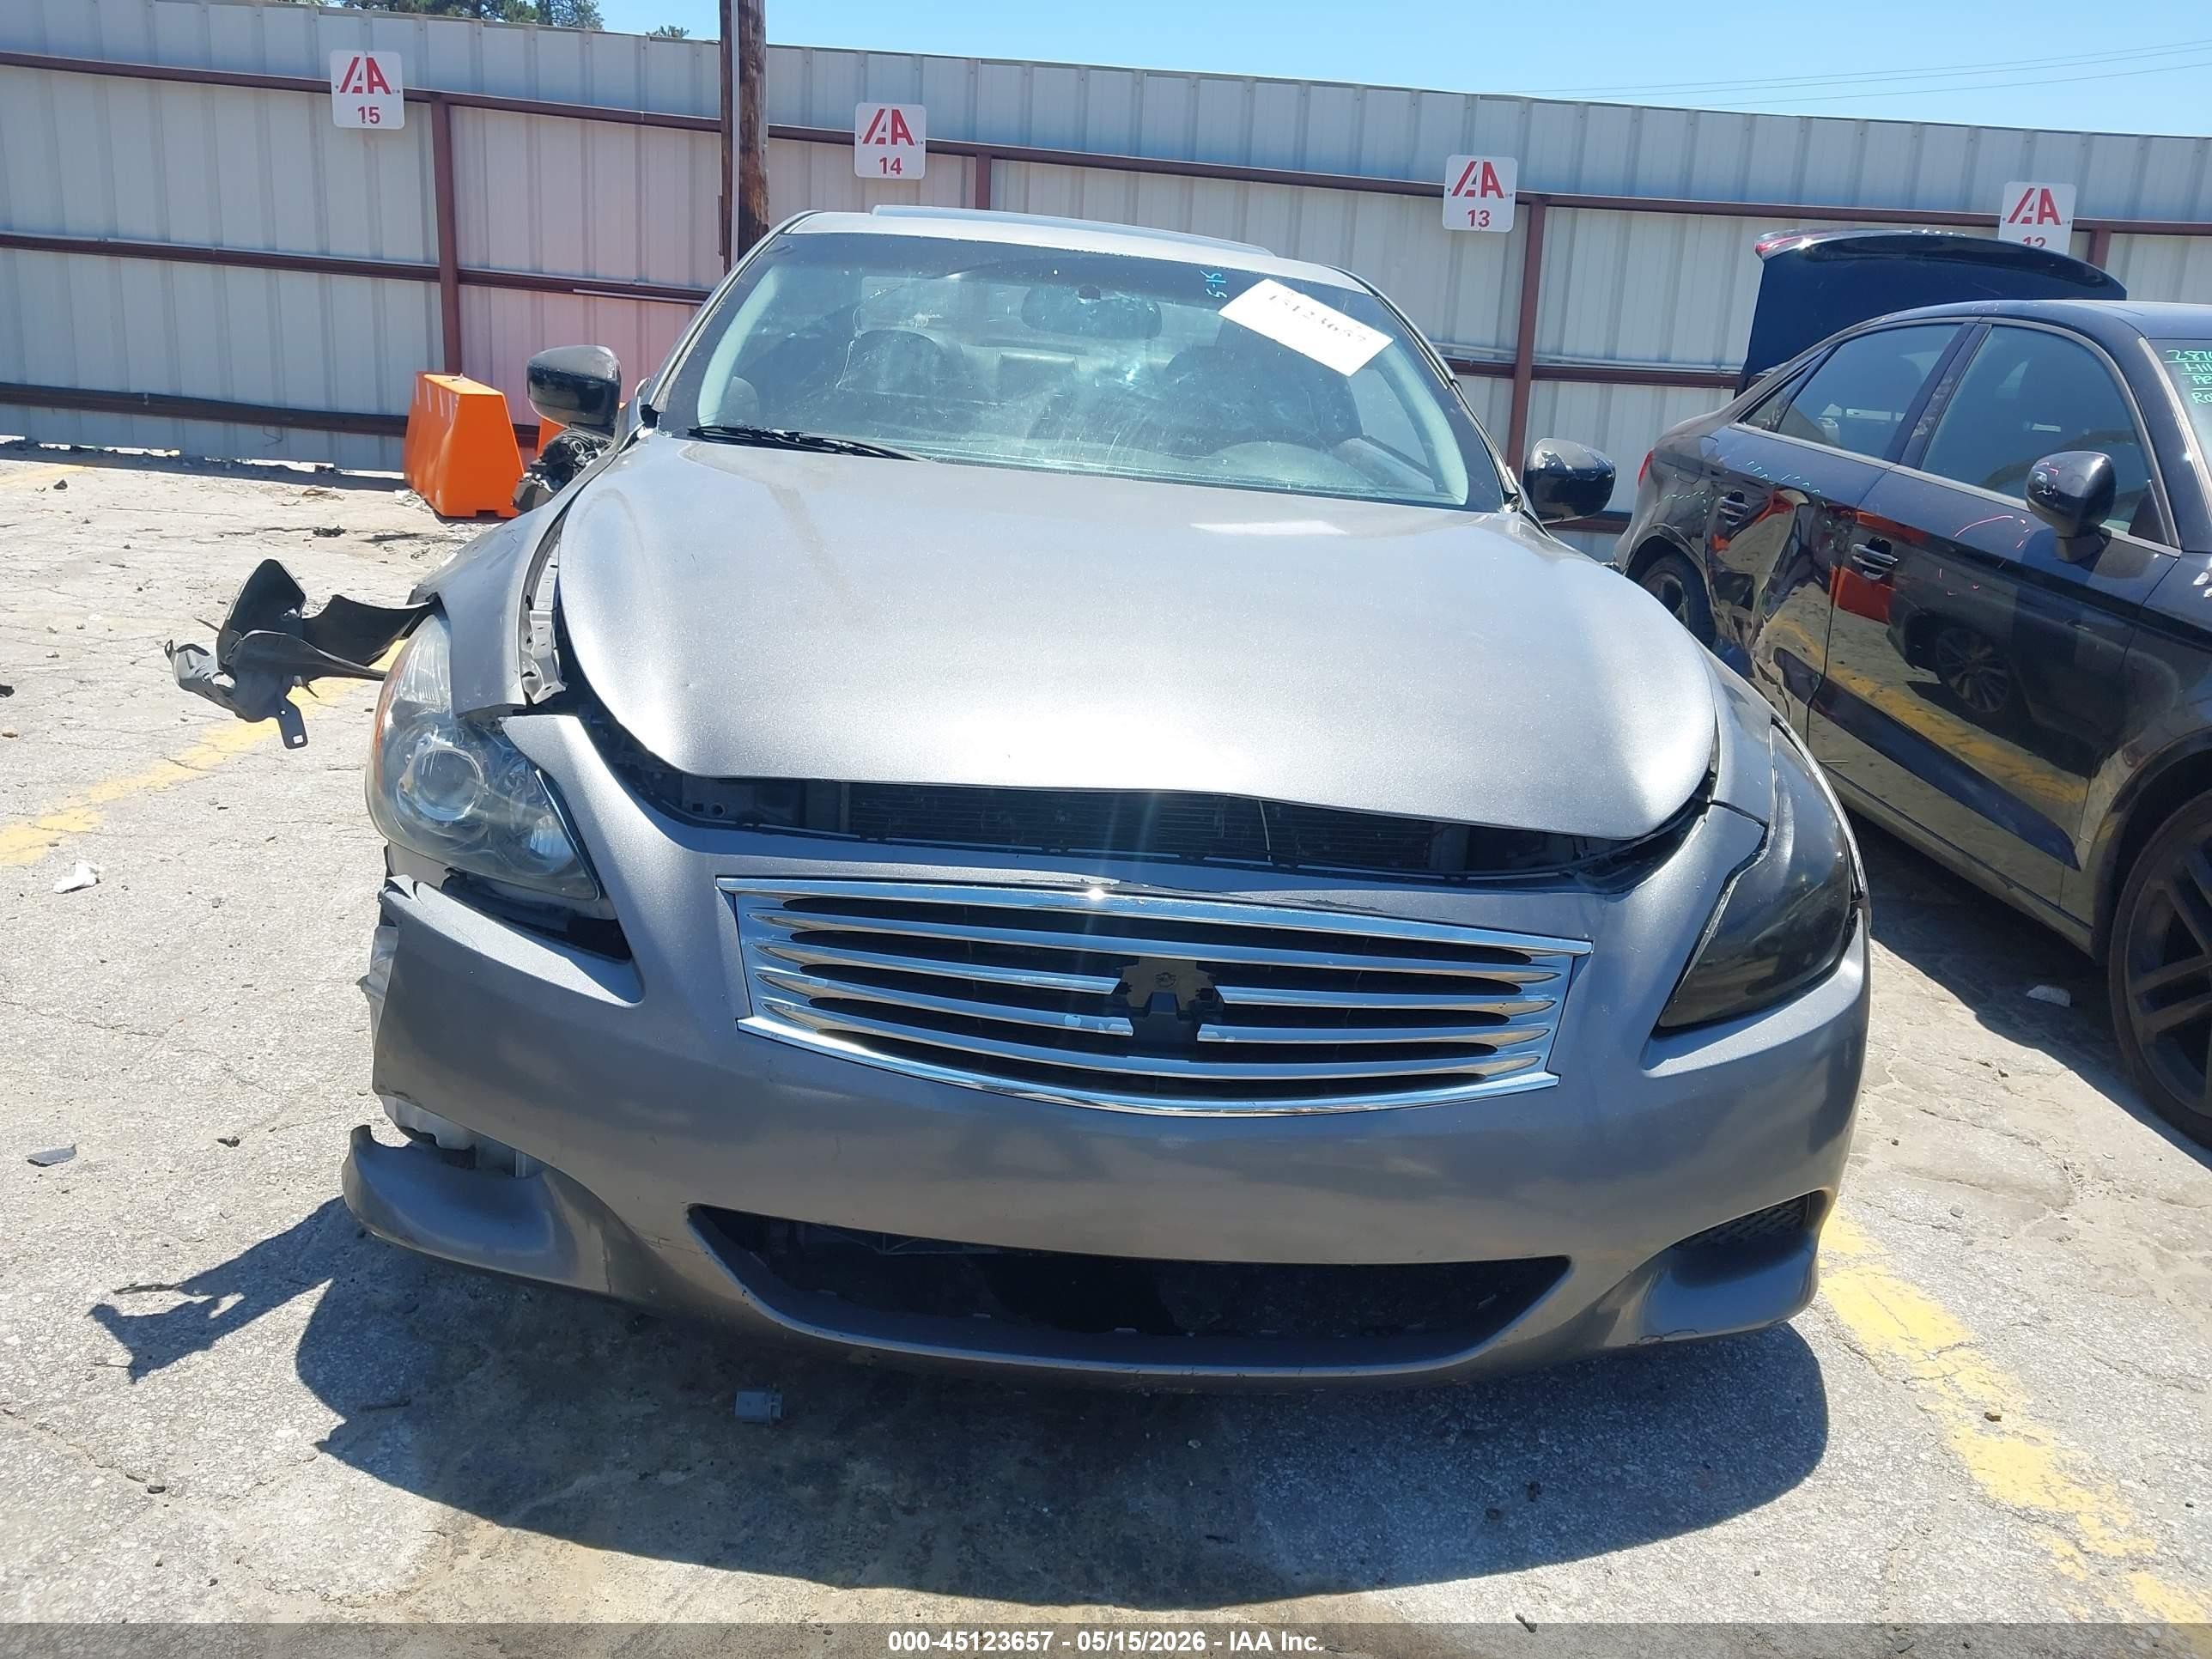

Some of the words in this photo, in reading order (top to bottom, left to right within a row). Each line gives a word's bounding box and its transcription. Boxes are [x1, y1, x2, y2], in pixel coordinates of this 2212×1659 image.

[357, 106, 380, 124] 15
[879, 156, 902, 174] 14
[1468, 209, 1490, 228] 13
